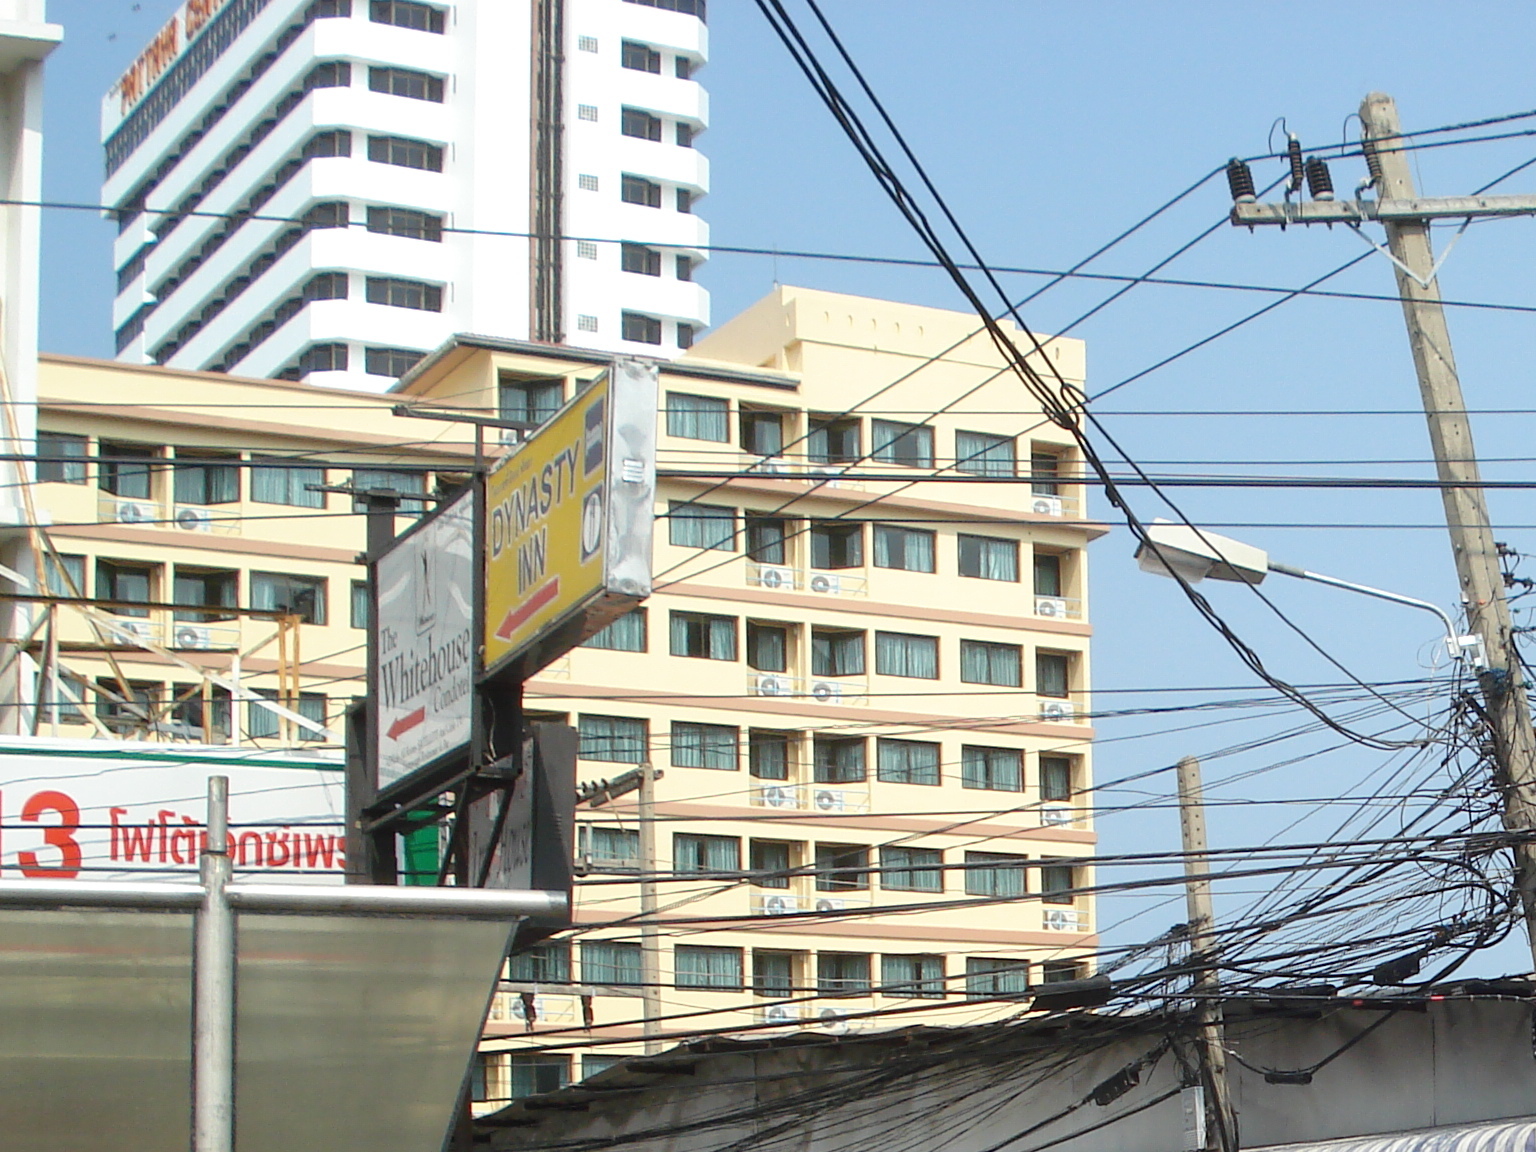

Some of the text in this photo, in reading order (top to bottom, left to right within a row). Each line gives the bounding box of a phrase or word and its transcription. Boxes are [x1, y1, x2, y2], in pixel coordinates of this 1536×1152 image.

[491, 438, 581, 560] DYNASTY
[518, 526, 548, 597] INN
[380, 625, 398, 656] The
[381, 627, 471, 713] Whitehouse
[433, 666, 471, 714] Condotel
[0, 789, 82, 879] 3
